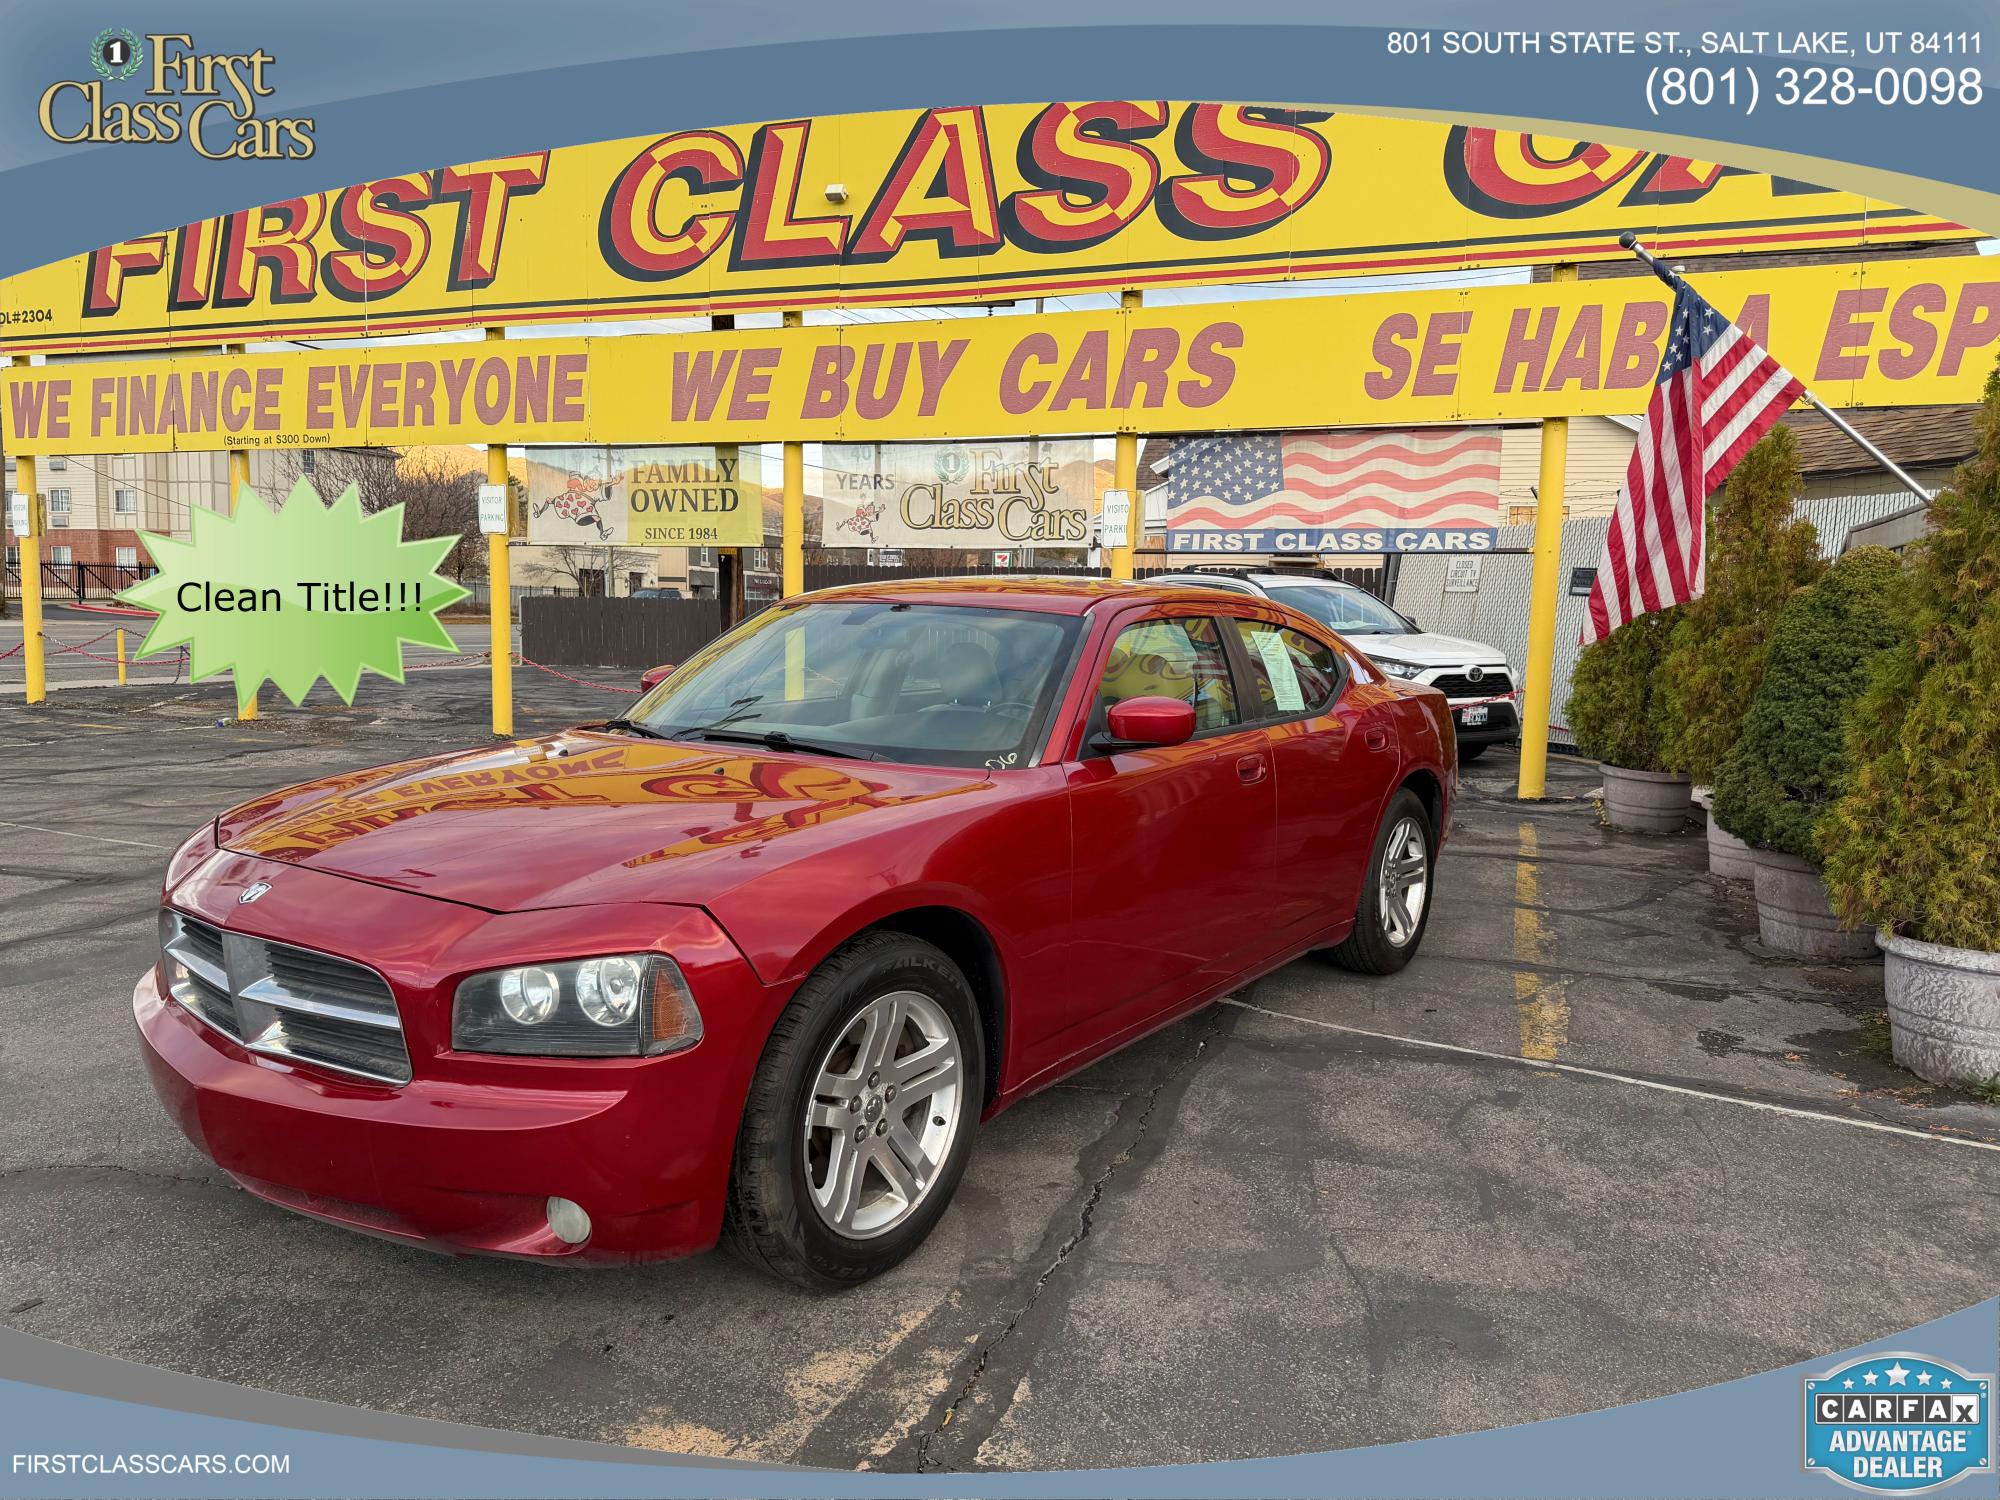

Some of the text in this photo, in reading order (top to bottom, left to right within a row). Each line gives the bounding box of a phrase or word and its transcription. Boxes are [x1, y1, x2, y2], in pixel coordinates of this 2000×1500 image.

[82, 149, 550, 317] FIRST
[599, 101, 1332, 282] CLASS
[1364, 281, 2000, 400] SE HABA ESP
[671, 322, 1245, 422] WE BUY CARS
[10, 354, 589, 439] WE FINANCE EVERYONE
[223, 433, 331, 447] (Starting at $300 Down)
[631, 458, 739, 484] FAMILY
[836, 473, 895, 490] YEARS
[970, 447, 1059, 513] First
[630, 487, 740, 513] OWNED
[899, 483, 1087, 541] Class Cars
[644, 527, 718, 540] SINCE 1984
[1172, 532, 1491, 550] FIRST CLASS CARS
